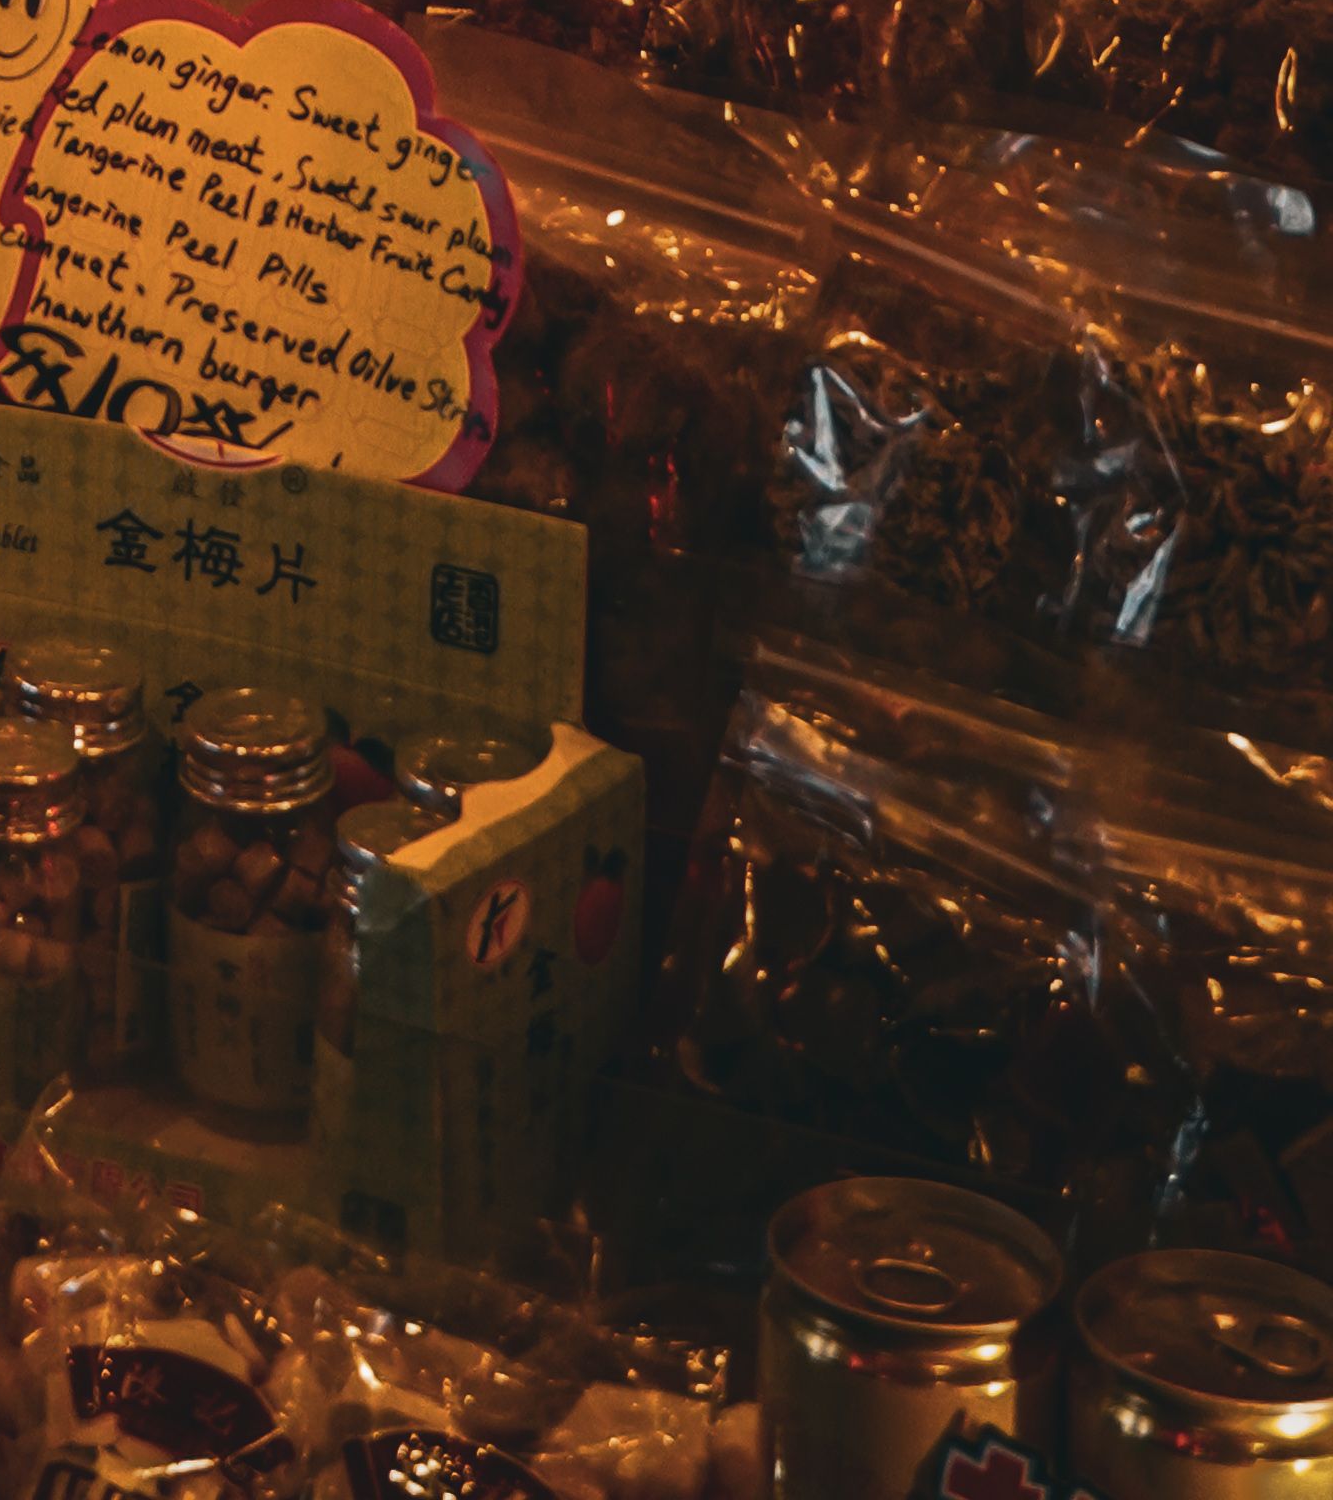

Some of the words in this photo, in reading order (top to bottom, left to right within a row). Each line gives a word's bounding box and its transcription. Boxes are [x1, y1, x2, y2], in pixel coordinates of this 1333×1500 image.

[50, 64, 109, 117] Red
[102, 90, 179, 145] plum
[69, 5, 167, 74] Lemon
[287, 84, 382, 153] Sweet
[11, 167, 144, 239] Tangerine
[164, 220, 240, 270] Peel
[257, 252, 330, 305] Pills
[53, 121, 188, 192] Tangerine
[199, 173, 257, 222] Peel
[370, 234, 435, 282] Fruit
[165, 271, 352, 375] Preserved
[198, 336, 323, 416] burger
[95, 506, 319, 605] 金梅片
